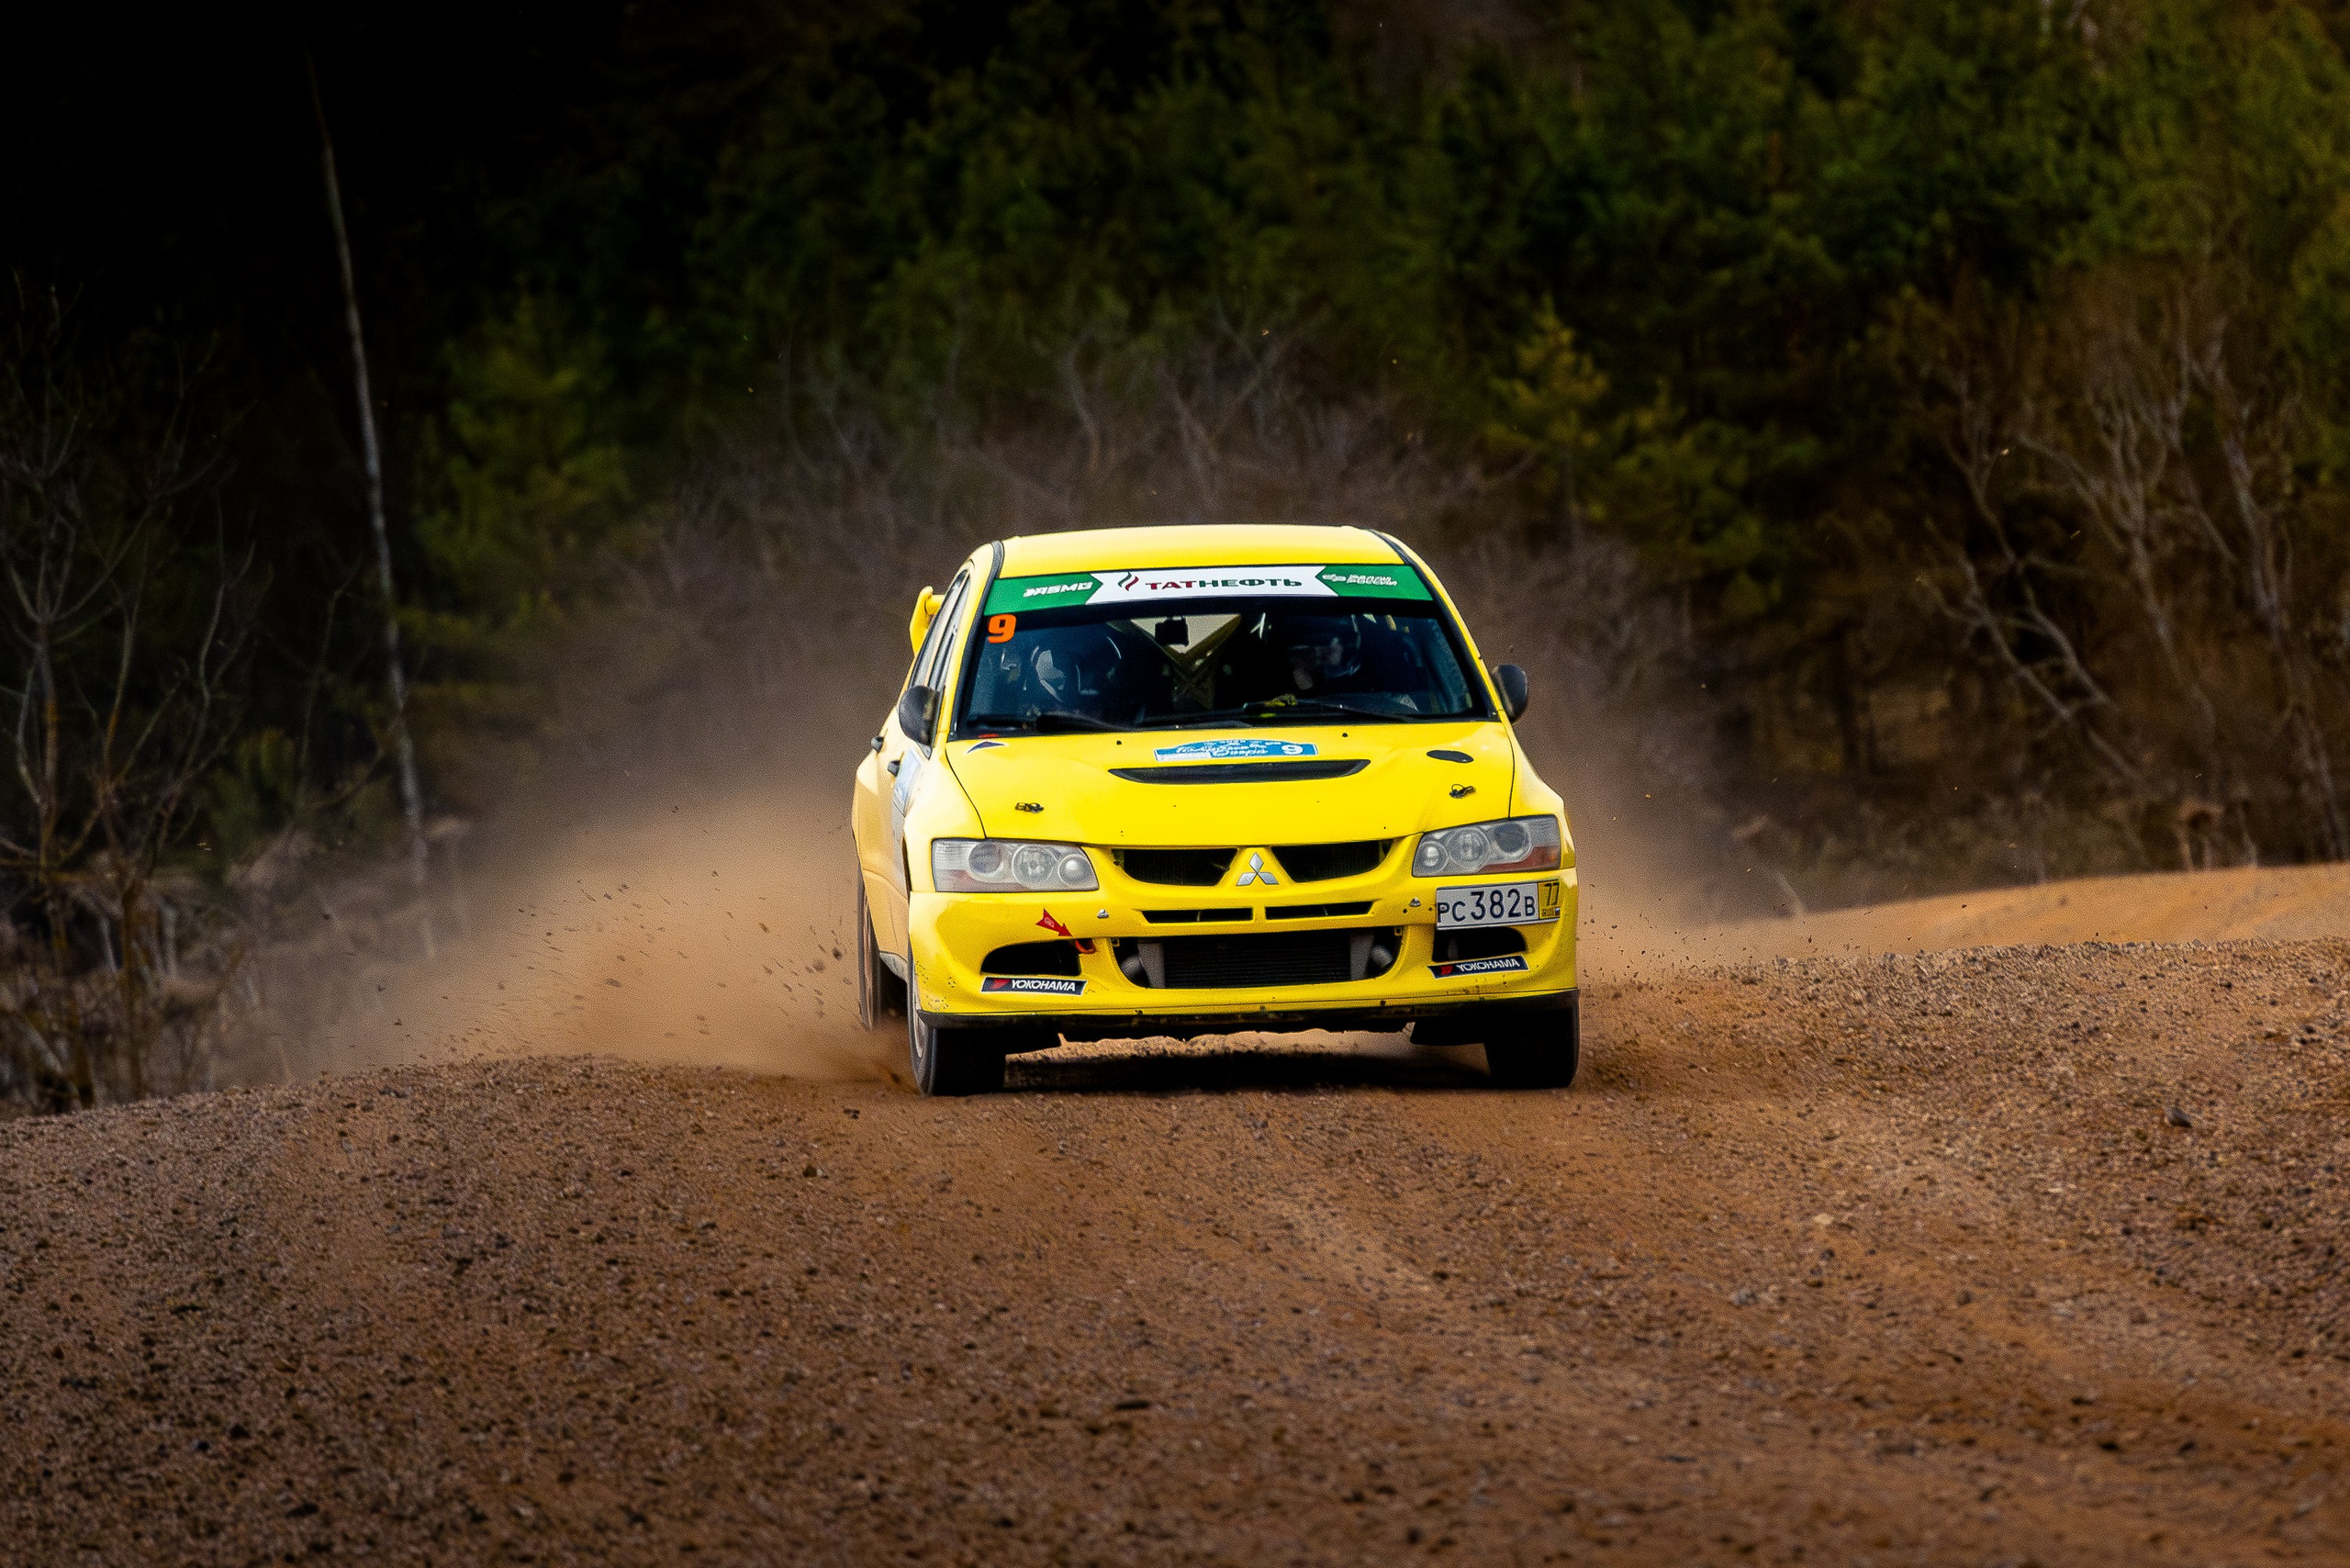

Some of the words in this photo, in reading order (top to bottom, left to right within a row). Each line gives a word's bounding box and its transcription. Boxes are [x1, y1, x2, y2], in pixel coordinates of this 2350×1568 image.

[1146, 578, 1302, 590] ТАТНЕФТЬ
[988, 613, 1016, 644] 9
[1281, 743, 1304, 755] 9
[1437, 889, 1536, 924] РС382В
[1544, 882, 1560, 906] 77
[1456, 958, 1520, 972] YOKOHAMA
[1011, 980, 1076, 991] YOKOHAMA
